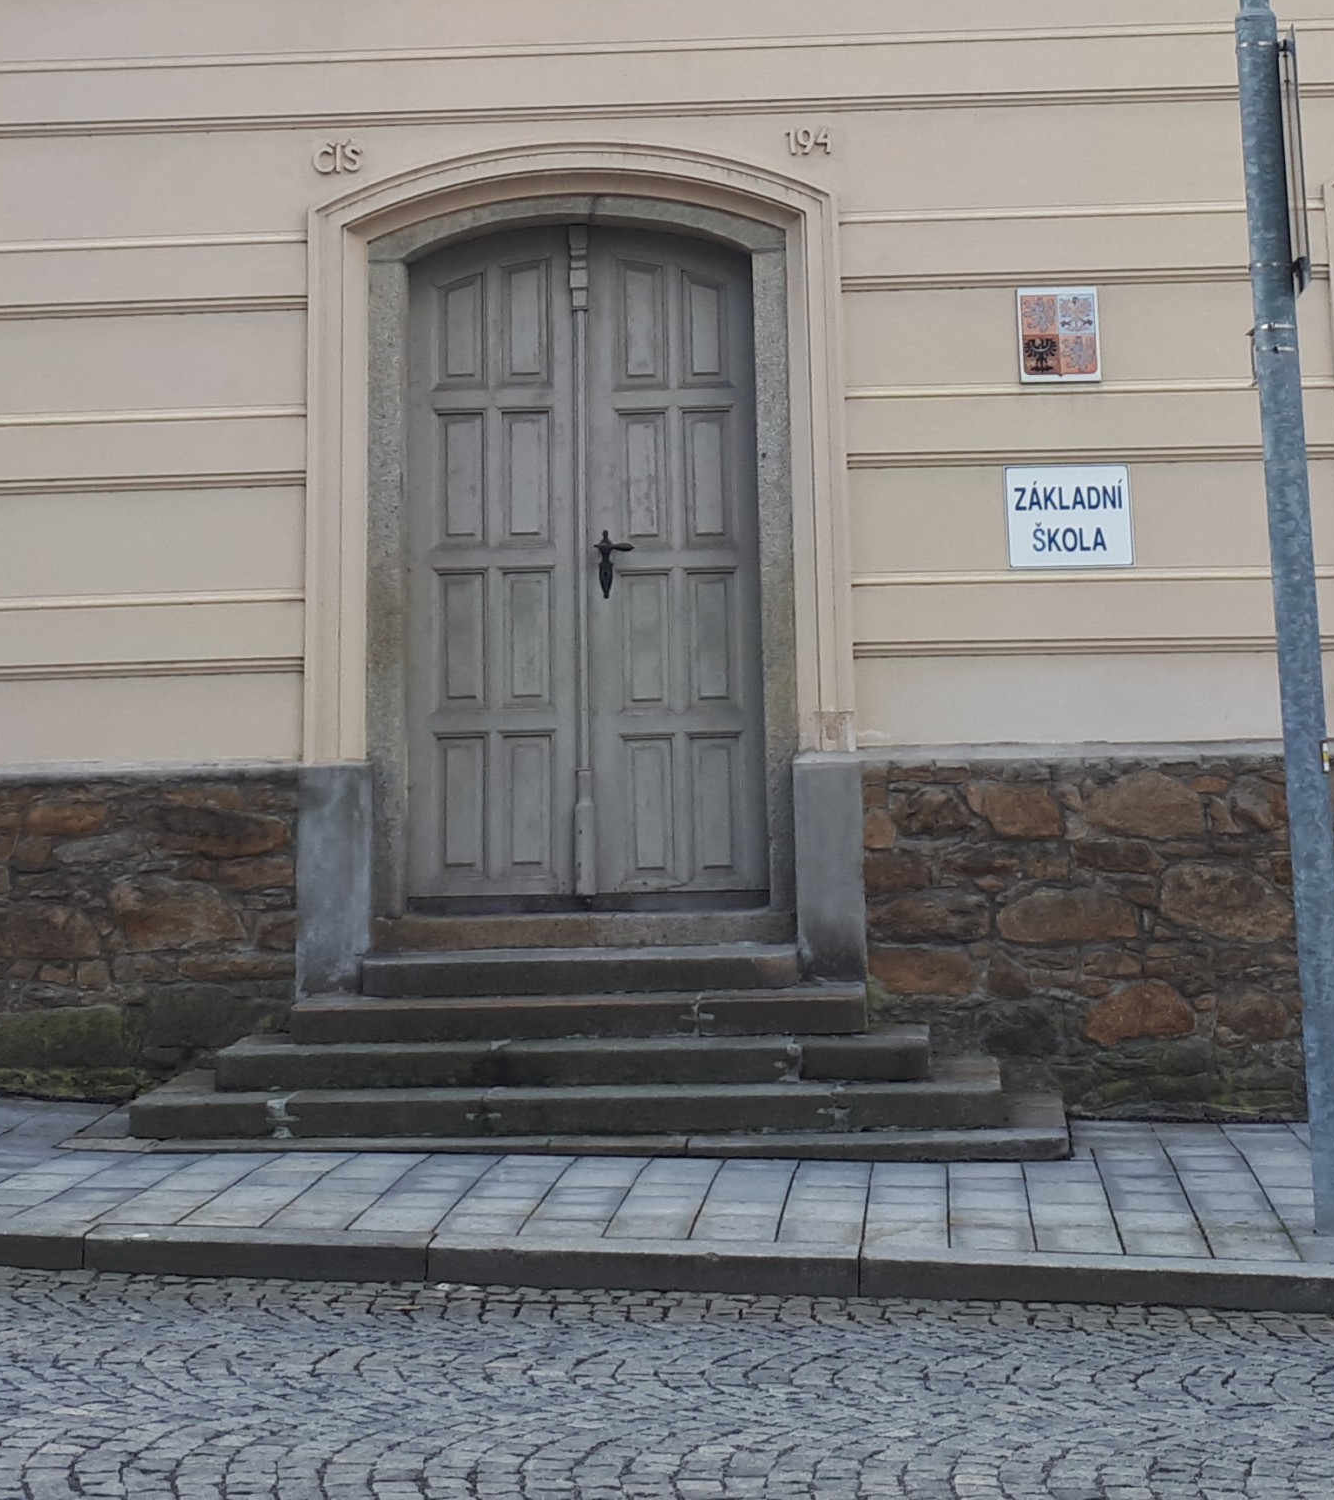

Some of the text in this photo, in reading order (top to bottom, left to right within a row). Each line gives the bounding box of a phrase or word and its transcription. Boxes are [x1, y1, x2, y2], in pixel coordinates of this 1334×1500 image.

[784, 126, 832, 156] 194
[1014, 478, 1123, 511] ZÁKLADNÍ
[1032, 521, 1108, 553] ŠKOLA
